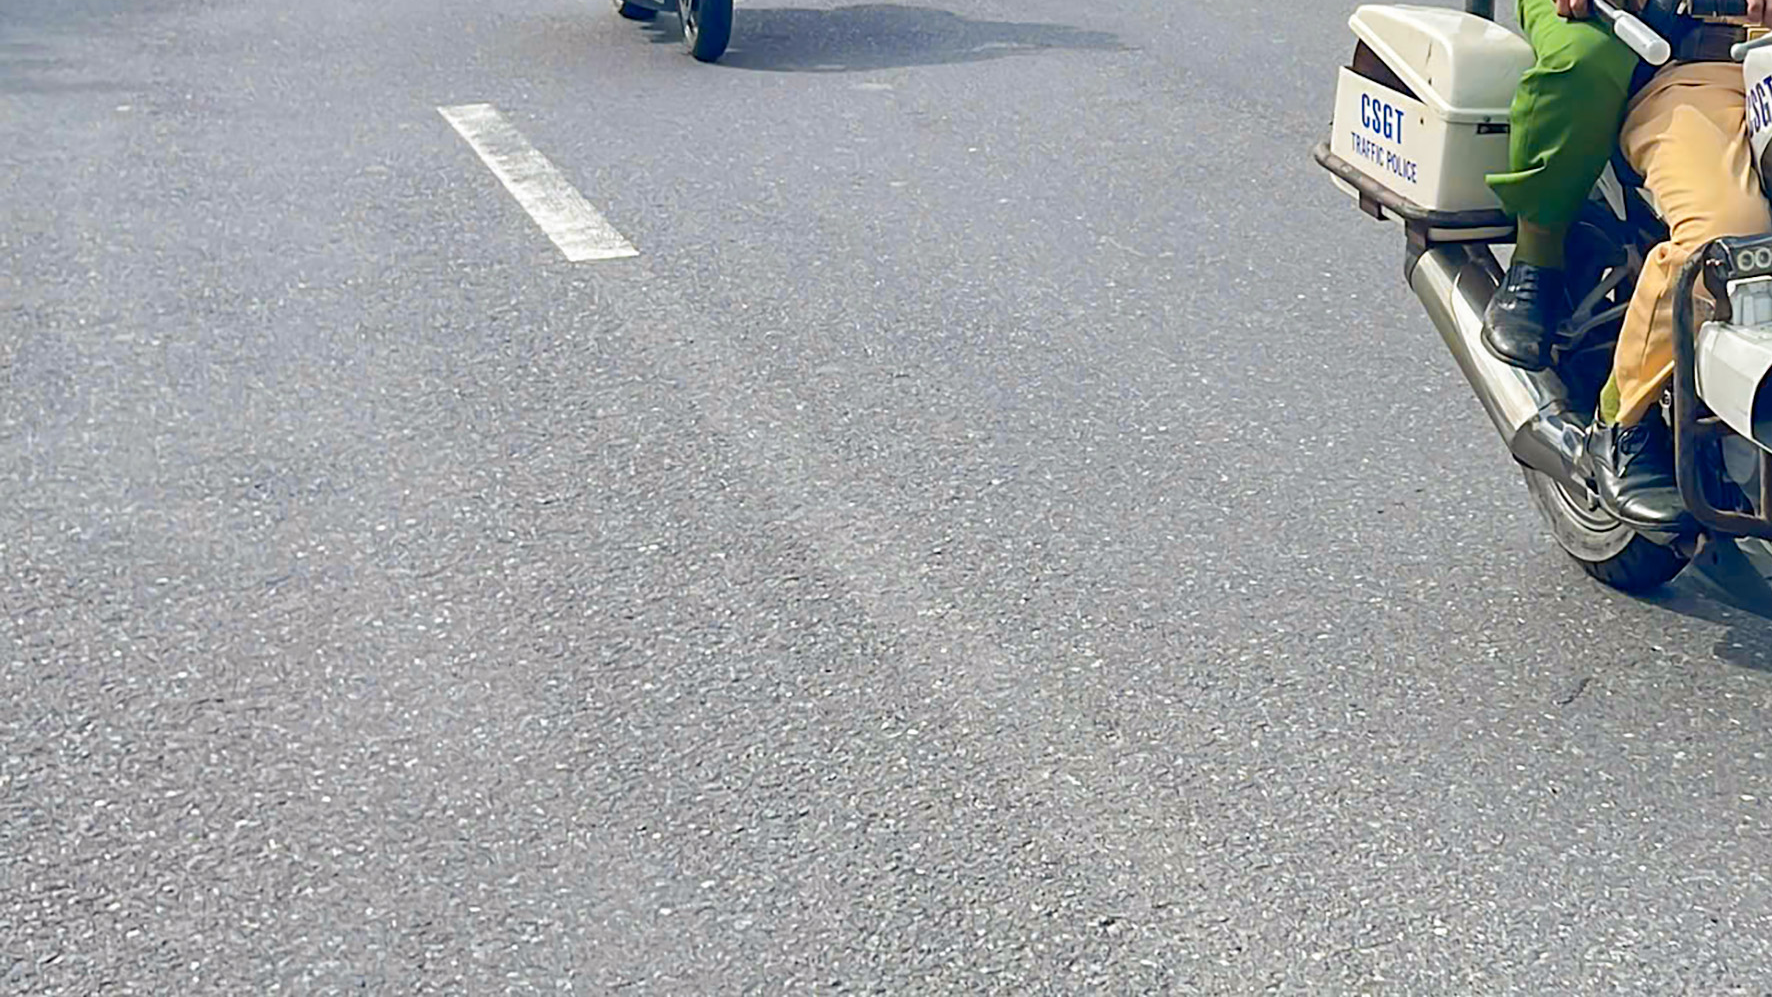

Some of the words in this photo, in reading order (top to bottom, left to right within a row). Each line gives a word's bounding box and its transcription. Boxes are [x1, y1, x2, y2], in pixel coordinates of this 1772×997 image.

[1361, 93, 1405, 145] CSGT
[1351, 131, 1384, 167] TRAFFIC
[1387, 150, 1417, 183] POLICE
